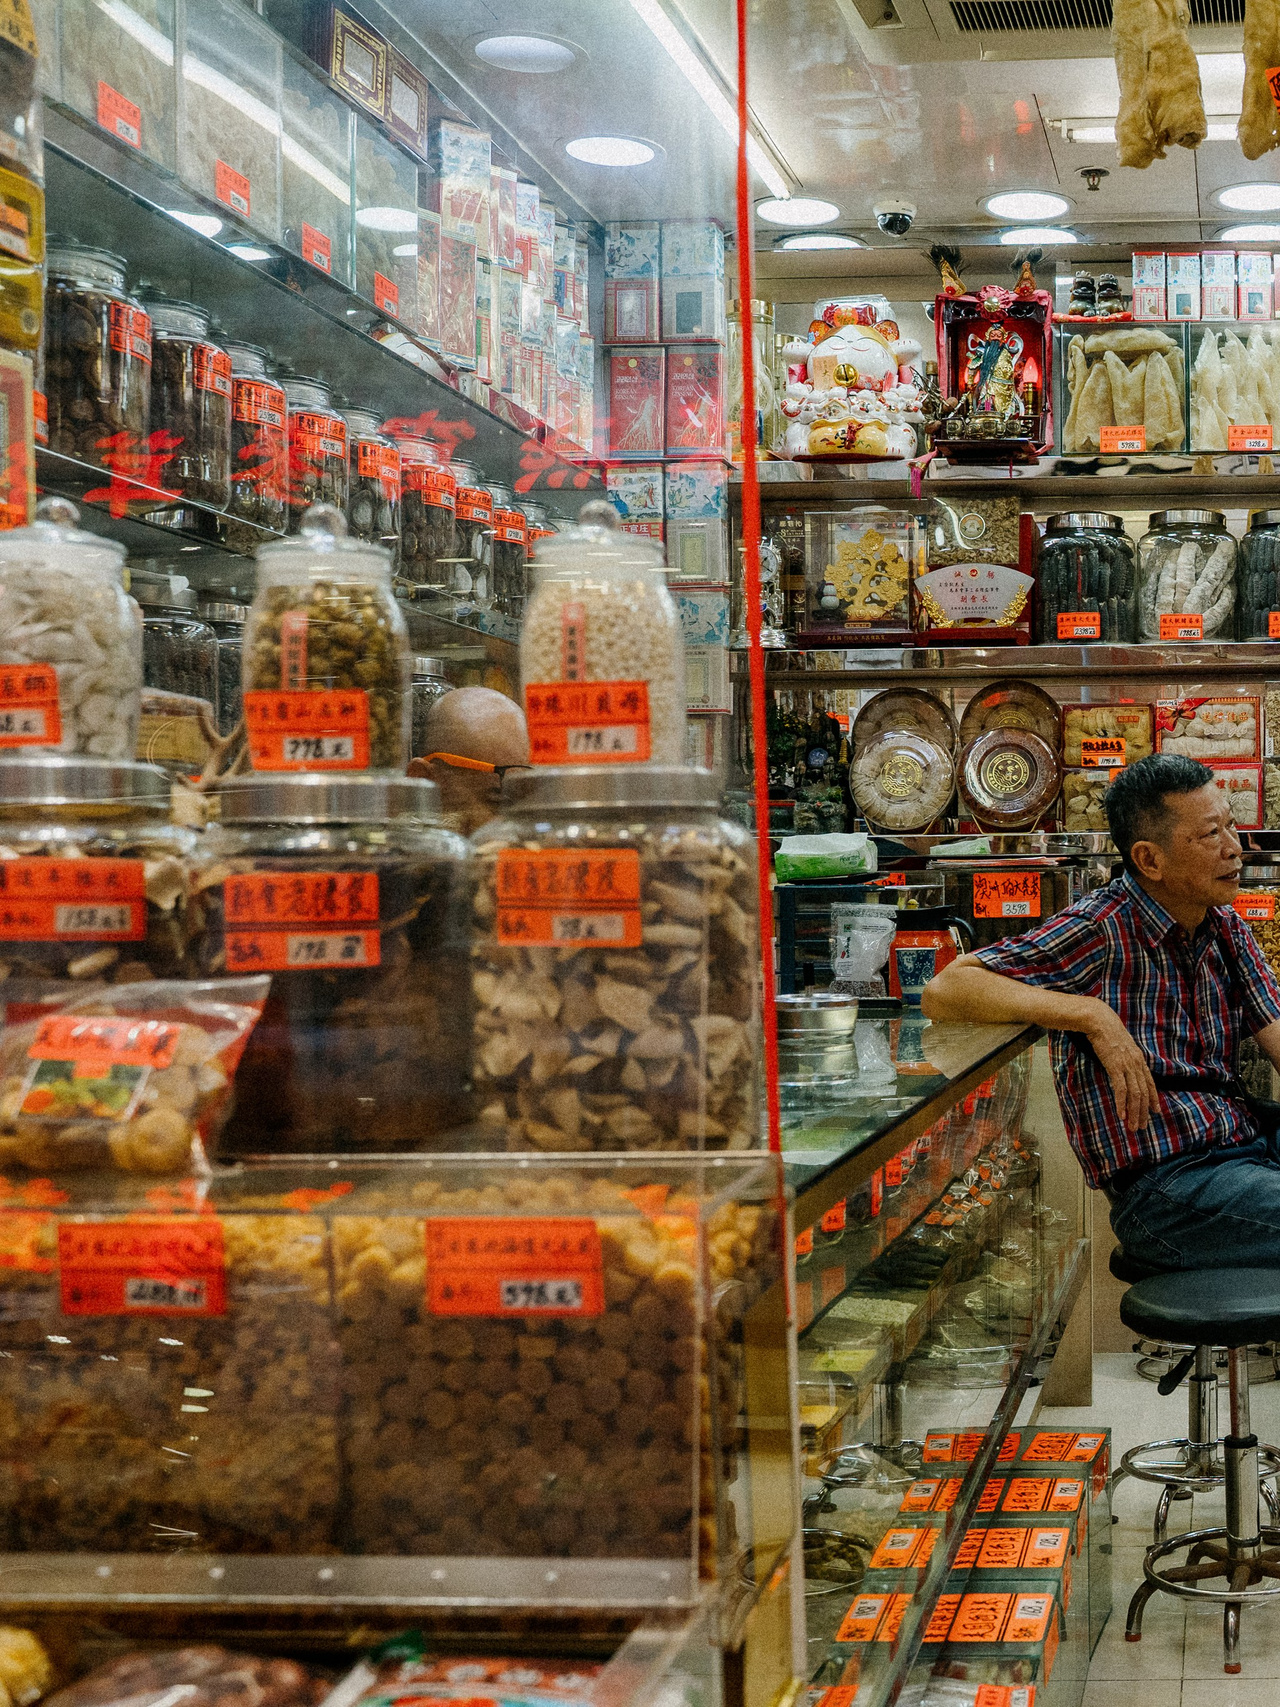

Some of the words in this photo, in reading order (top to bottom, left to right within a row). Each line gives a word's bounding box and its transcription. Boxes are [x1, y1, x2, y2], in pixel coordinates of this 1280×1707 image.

[620, 523, 649, 534] 正官庄
[1004, 903, 1028, 915] 3598
